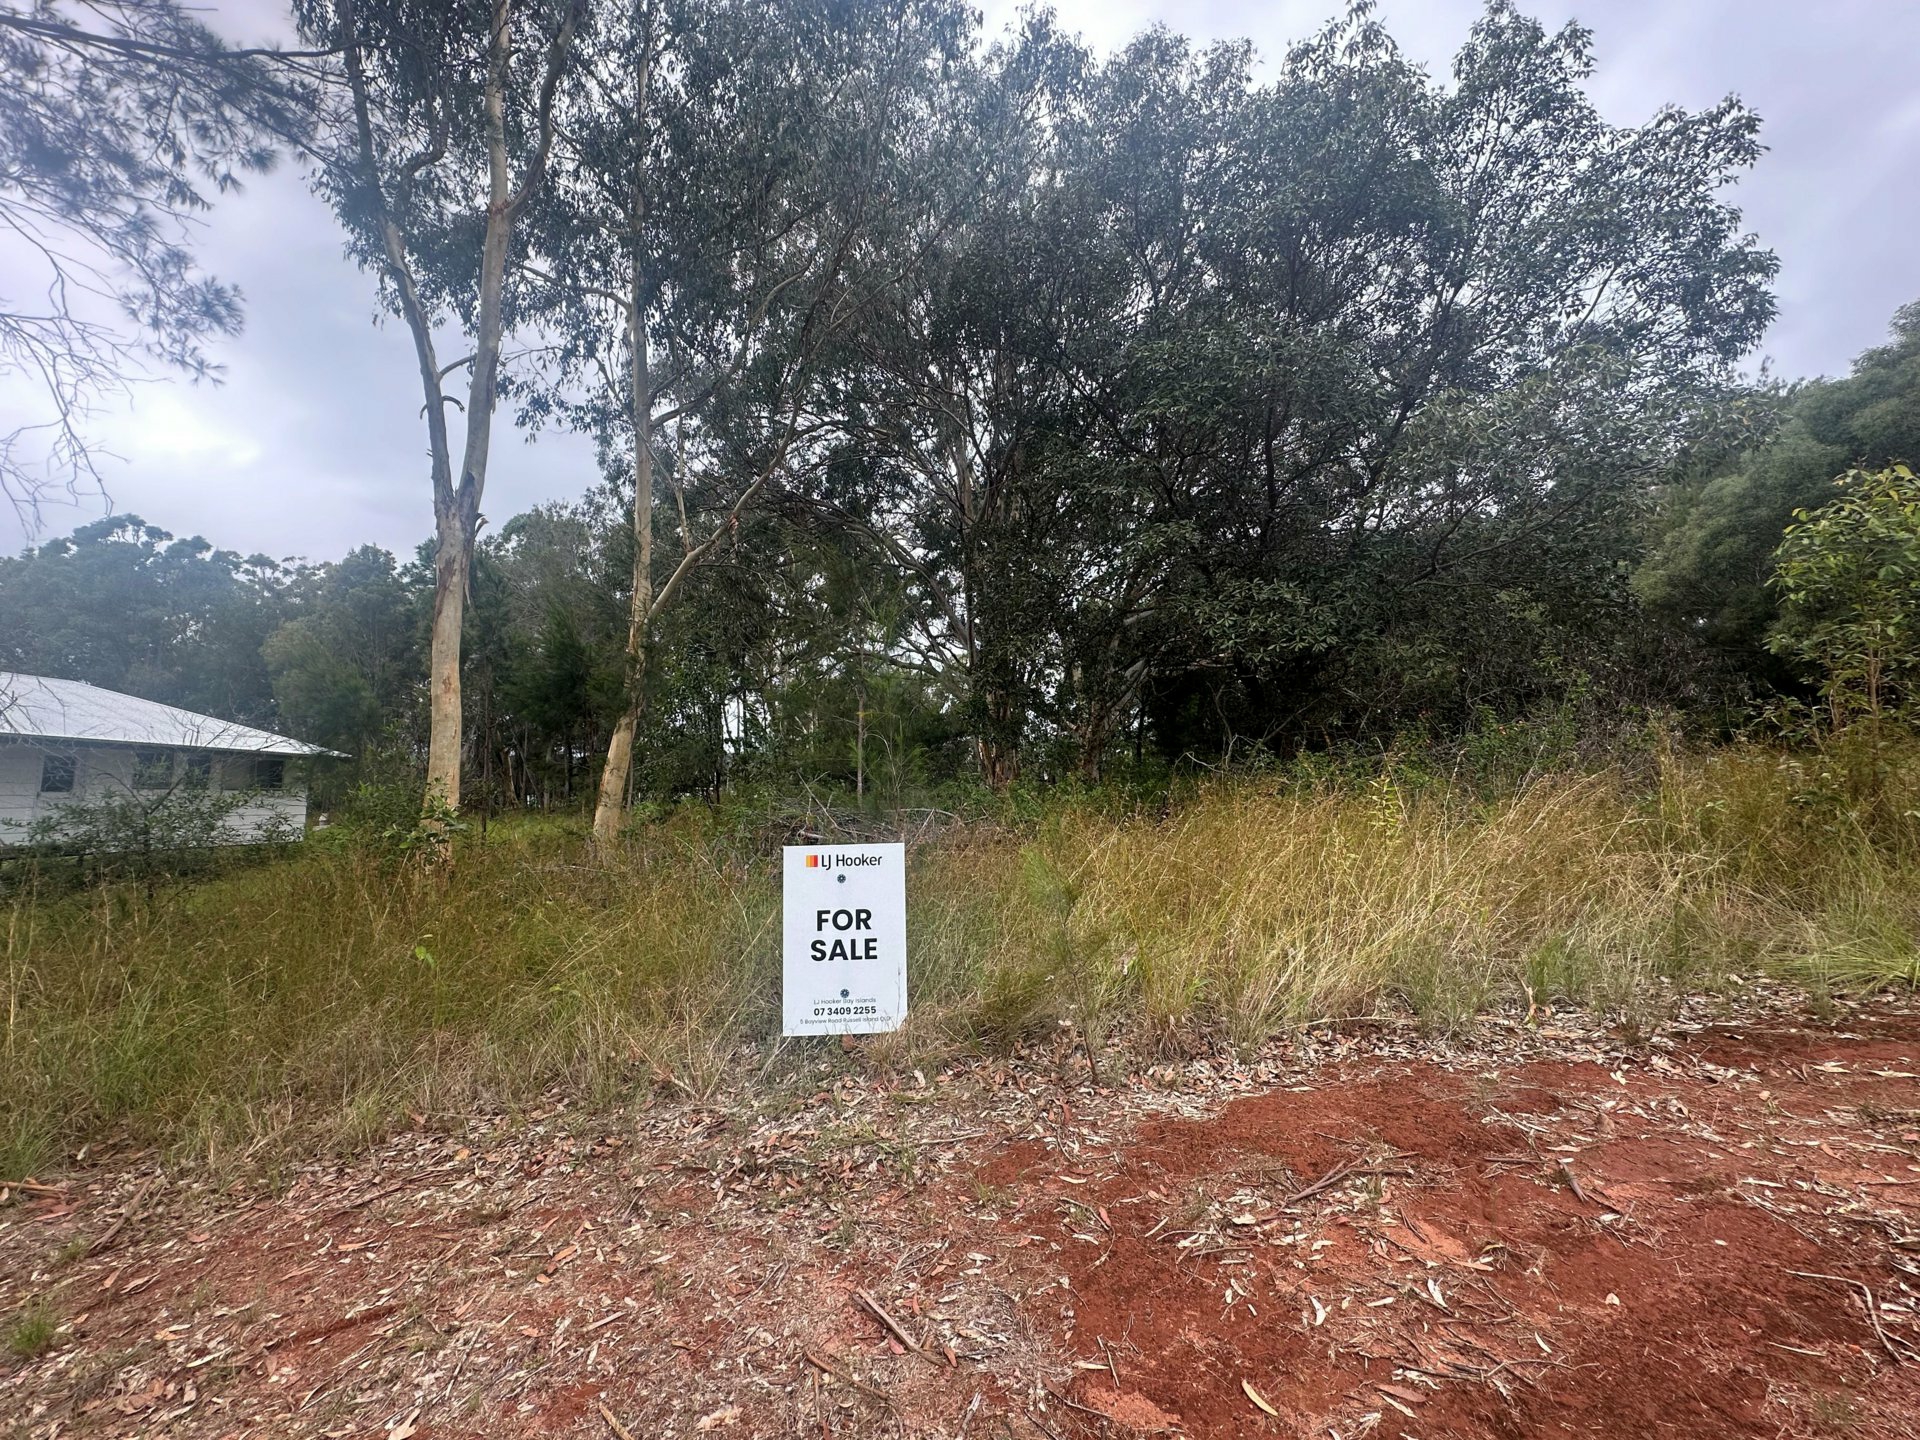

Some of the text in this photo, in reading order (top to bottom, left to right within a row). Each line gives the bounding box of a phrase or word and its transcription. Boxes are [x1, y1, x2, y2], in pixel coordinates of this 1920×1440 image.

[821, 853, 883, 871] LJ Hooker
[816, 908, 872, 932] FOR
[810, 938, 878, 962] SALE
[813, 1006, 877, 1016] 07 3409 2255
